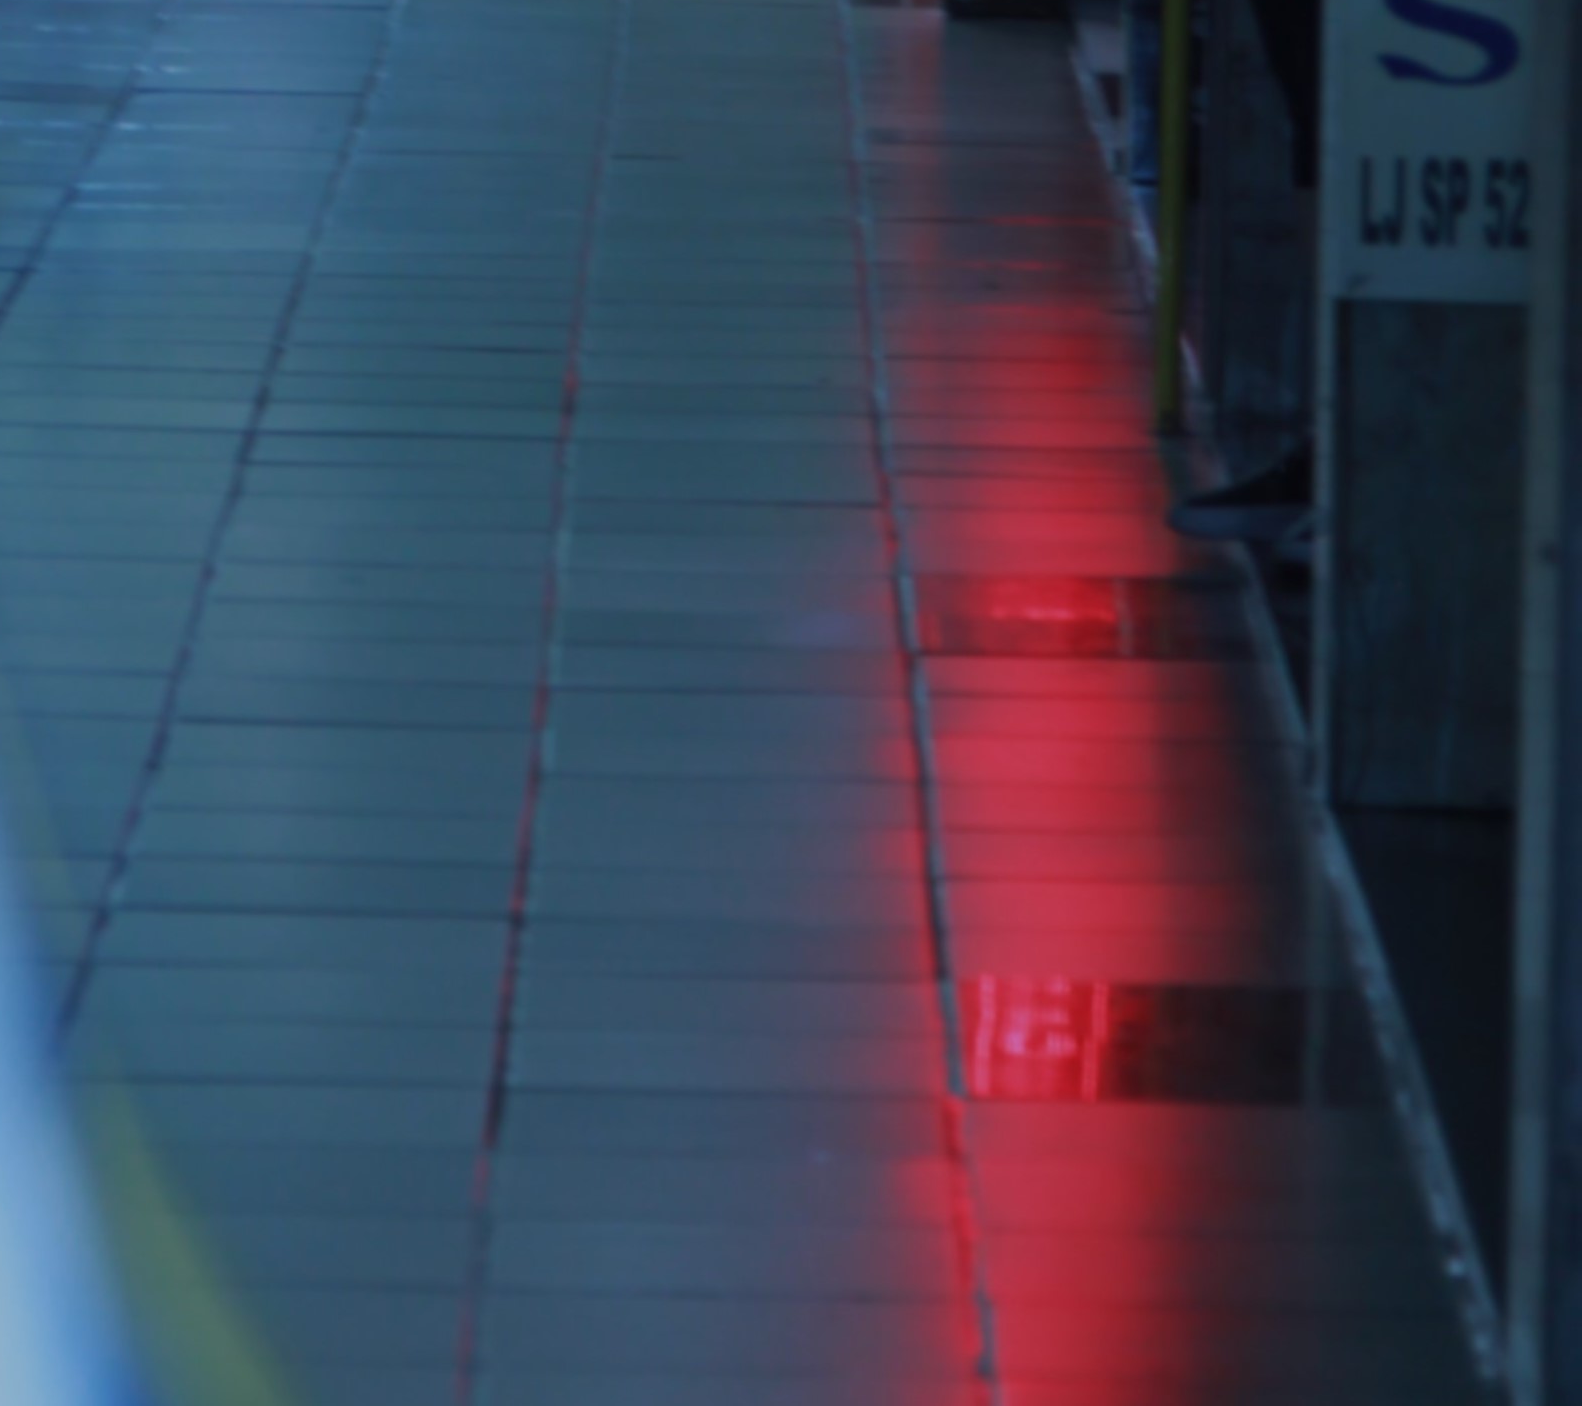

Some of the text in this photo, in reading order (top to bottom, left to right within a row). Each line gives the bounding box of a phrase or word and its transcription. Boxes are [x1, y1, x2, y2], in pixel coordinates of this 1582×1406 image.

[1359, 155, 1530, 250] LJ SP 52
